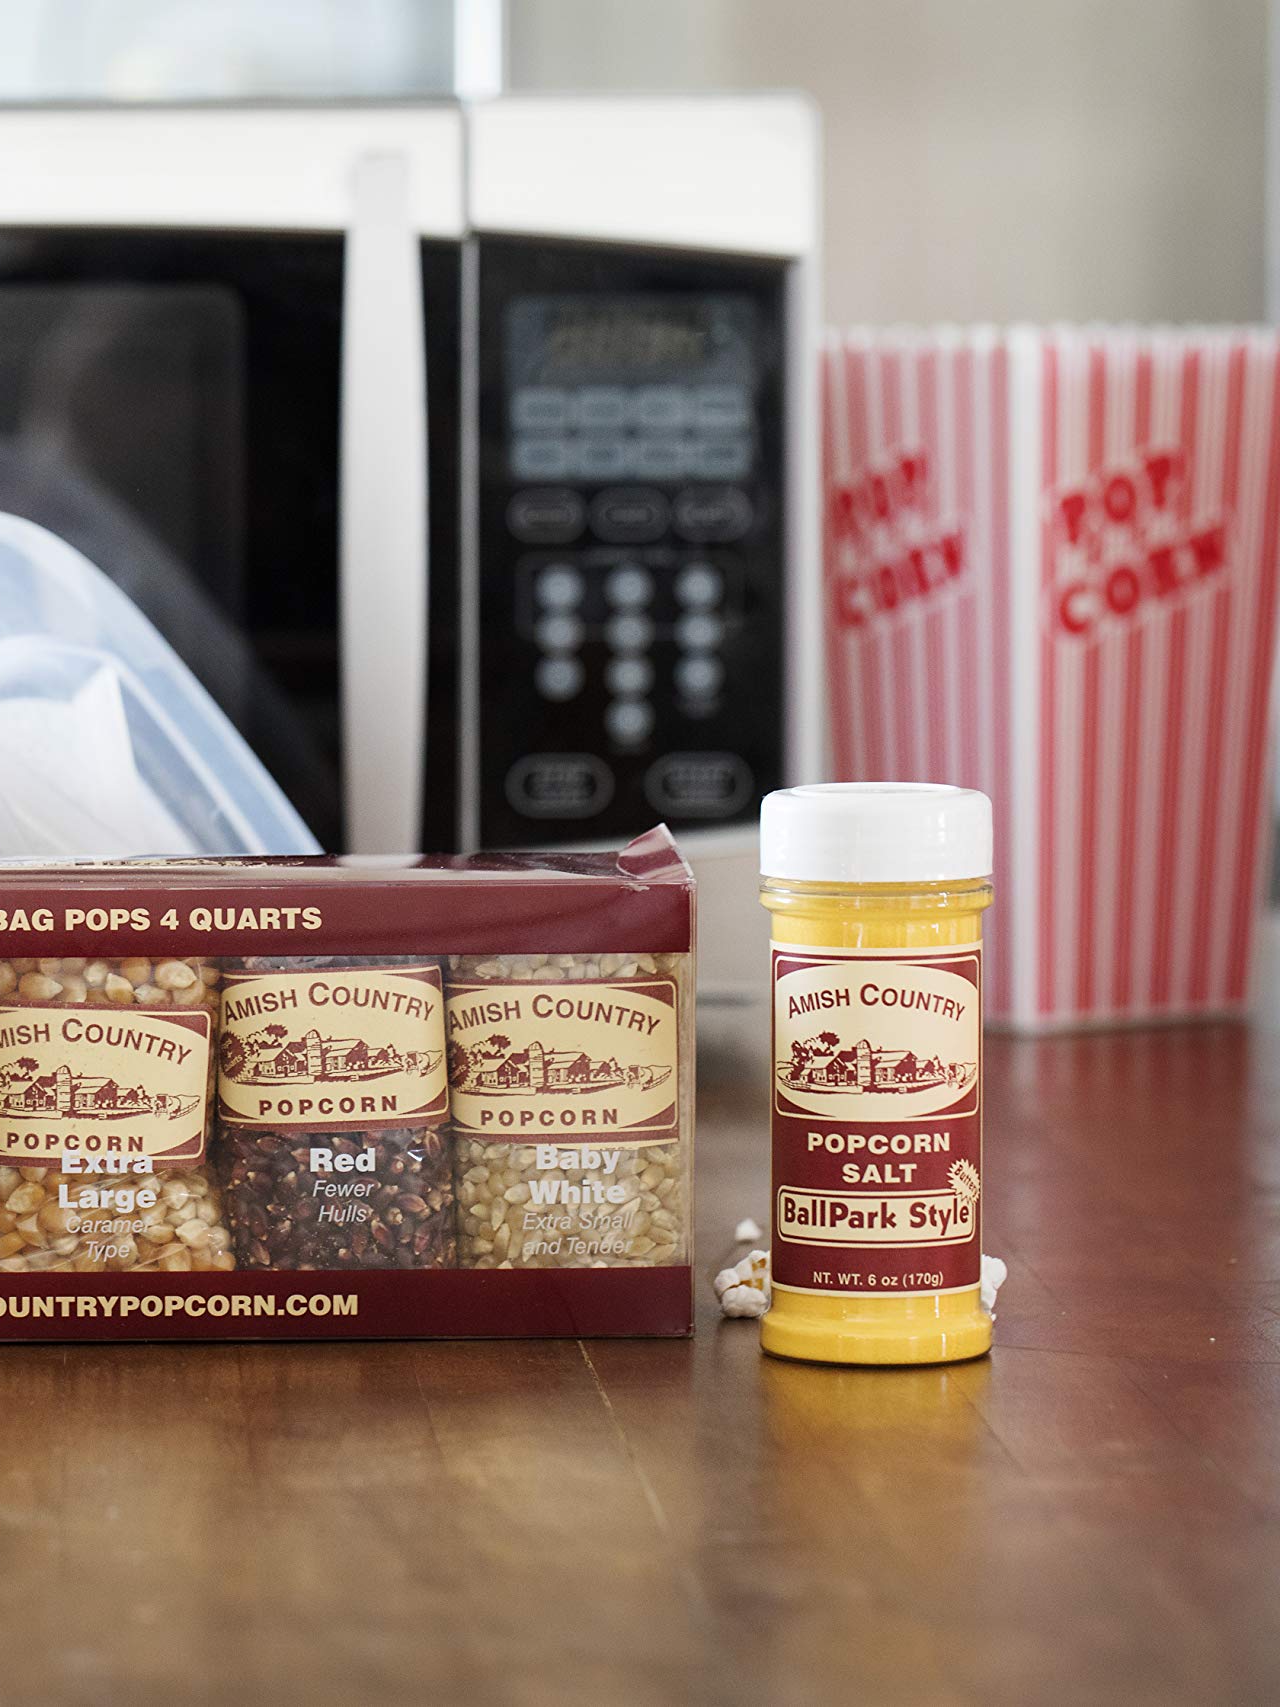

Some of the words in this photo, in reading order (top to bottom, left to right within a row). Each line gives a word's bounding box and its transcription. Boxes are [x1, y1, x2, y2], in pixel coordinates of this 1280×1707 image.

[65, 908, 150, 931] POPS
[160, 908, 180, 930] 4
[189, 907, 323, 932] QUARTS
[225, 989, 298, 1026] AMISH
[308, 982, 435, 1022] COUNTRY
[788, 988, 850, 1019] AMISH
[859, 983, 966, 1022] COUNTRY
[448, 1000, 521, 1035] AMISH
[532, 994, 661, 1036] COUNTRY
[61, 1018, 192, 1065] COUNTRY
[259, 1095, 398, 1116] POPCORN
[480, 1108, 618, 1126] POPCORN
[6, 1132, 144, 1152] POPCORN
[807, 1132, 950, 1155] POPCORN
[61, 1150, 153, 1174] Extra
[310, 1148, 376, 1173] Red
[536, 1145, 621, 1174] Baby
[842, 1163, 917, 1184] SALT
[58, 1184, 157, 1214] Large
[313, 1180, 375, 1197] Fewer
[528, 1180, 626, 1204] White
[66, 1216, 149, 1234] Caramel
[318, 1205, 367, 1222] Hulls
[523, 1213, 572, 1230] Extra
[579, 1212, 634, 1230] Small
[784, 1196, 897, 1229] BallPark
[909, 1198, 969, 1236] Style
[85, 1241, 130, 1262] Type
[523, 1237, 562, 1255] and
[567, 1237, 633, 1255] Tender
[813, 1272, 833, 1285] NT.
[838, 1273, 863, 1286] WT.
[868, 1274, 876, 1286] 6
[881, 1276, 898, 1286] oz
[903, 1271, 943, 1288] (170g)
